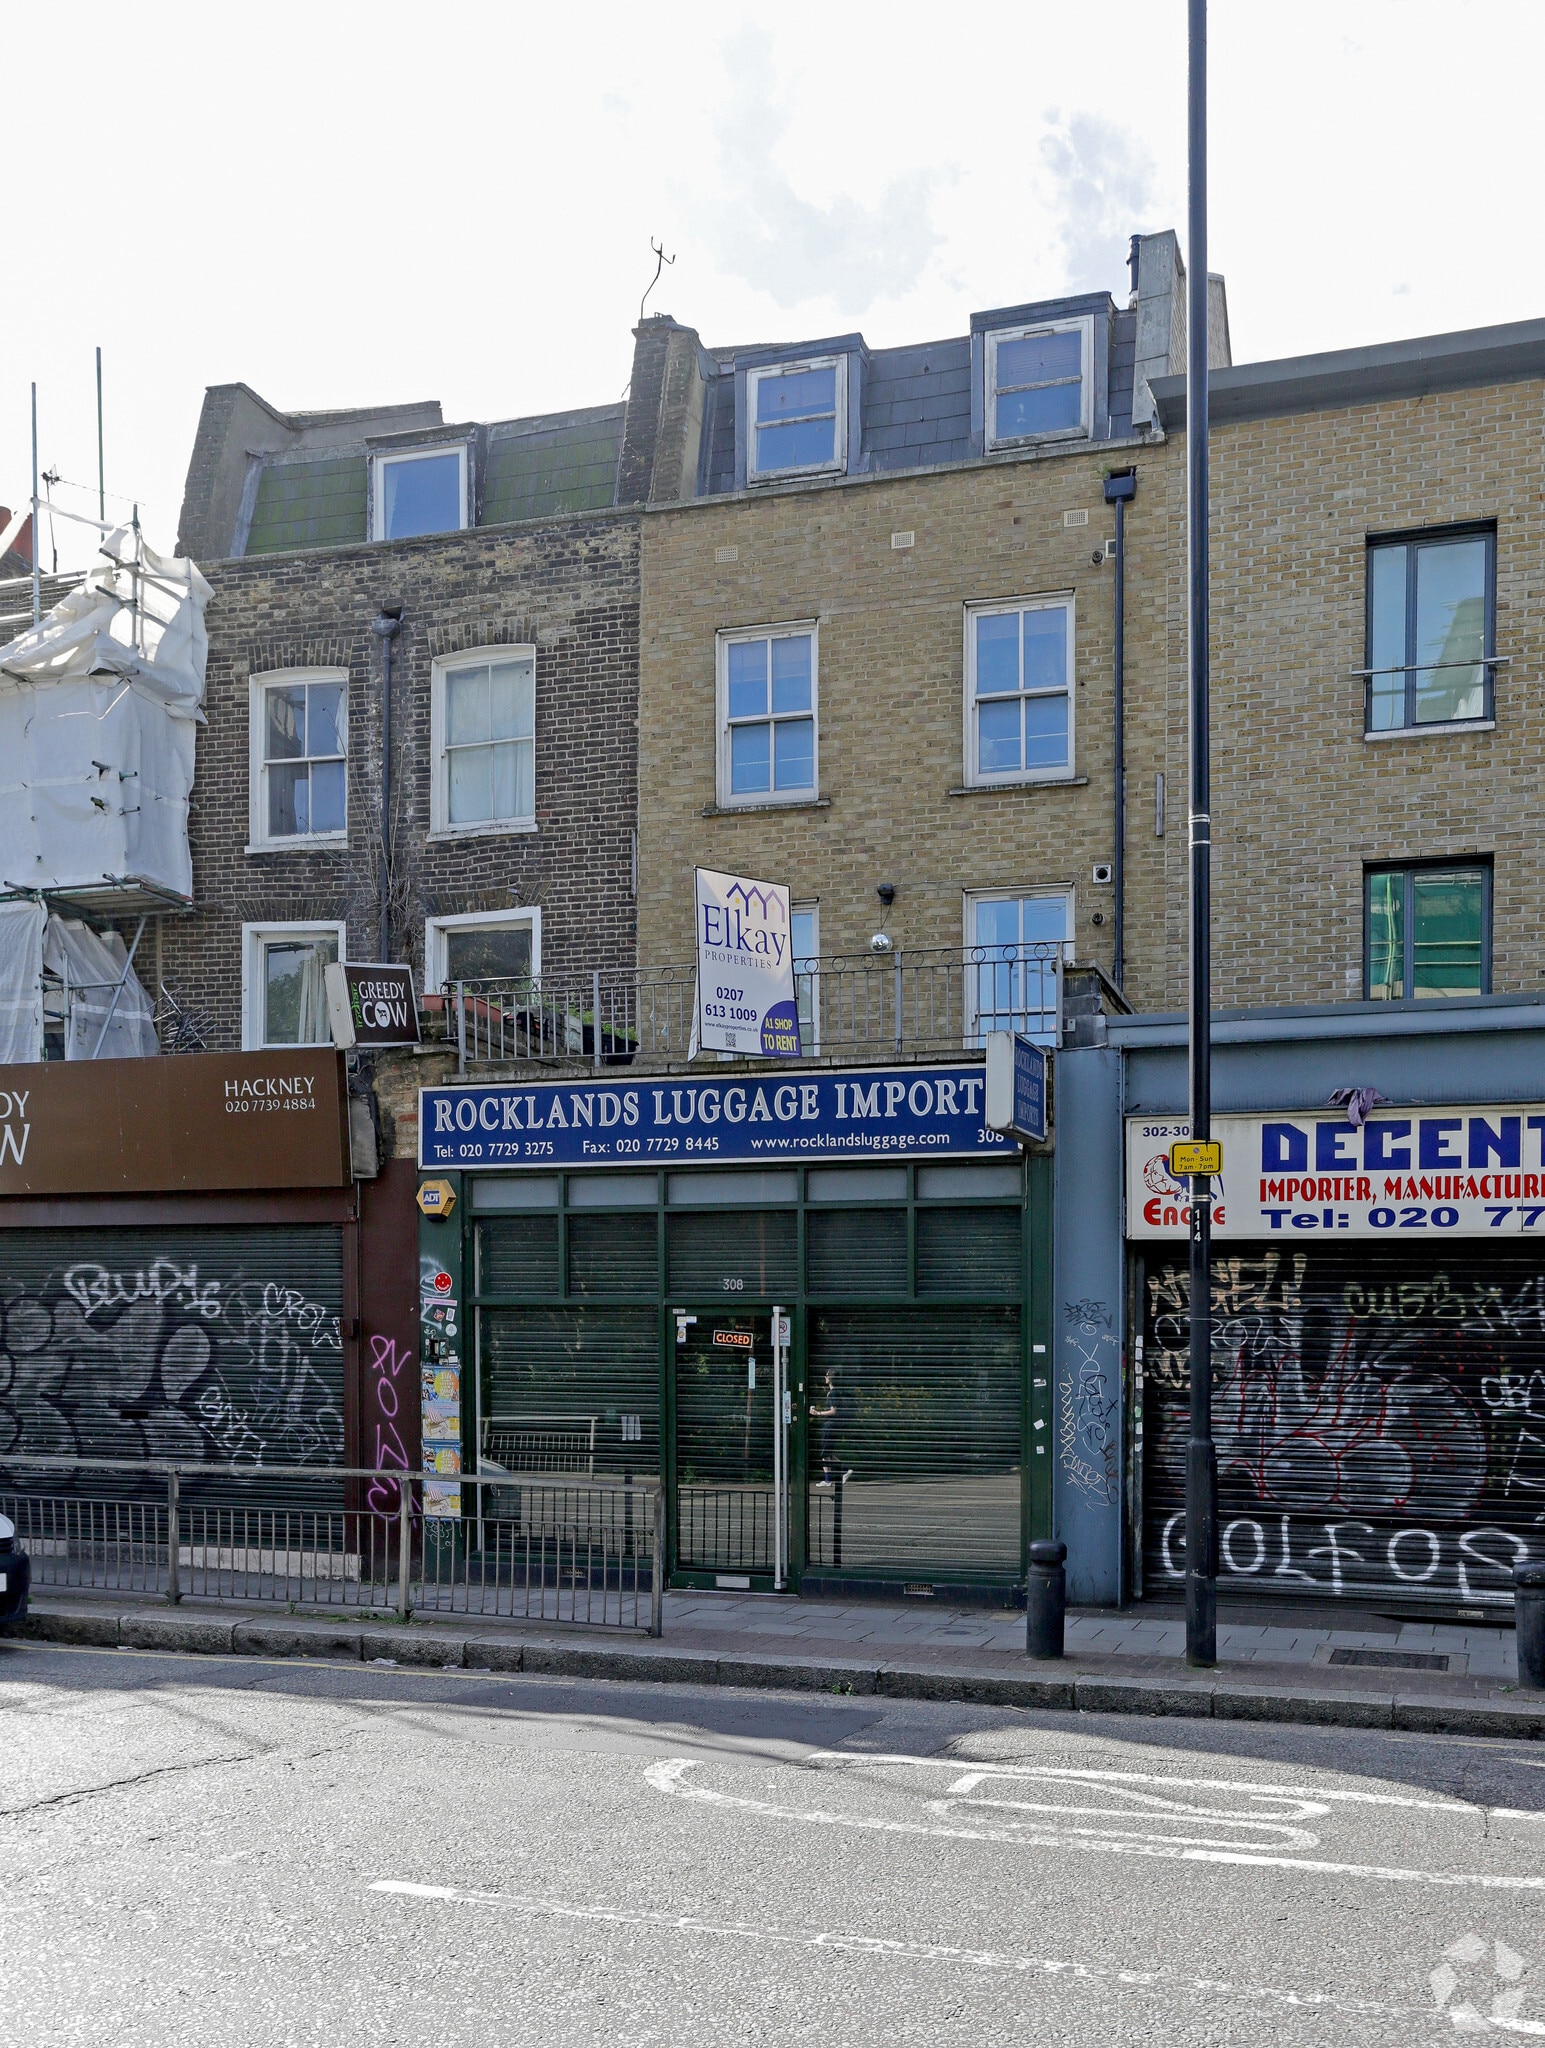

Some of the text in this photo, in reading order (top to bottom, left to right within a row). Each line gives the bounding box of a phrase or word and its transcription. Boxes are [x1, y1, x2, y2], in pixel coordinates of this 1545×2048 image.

[701, 903, 787, 966] Elkay
[704, 950, 772, 969] PROPERTIES
[358, 981, 405, 999] GREEDY
[716, 986, 744, 1001] 0207
[362, 1001, 407, 1028] COW
[705, 1003, 757, 1022] 613 1009
[765, 1017, 793, 1030] A1 SHOP
[763, 1033, 797, 1052] TO RENT
[224, 1077, 316, 1098] HACKNEY
[225, 1098, 316, 1113] 020 7739 4884
[433, 1091, 640, 1132] ROCKLANDS
[652, 1083, 820, 1125] LUGGAGE
[434, 1144, 454, 1158] Tel:
[459, 1143, 483, 1157] 020
[488, 1142, 519, 1156] 7729
[524, 1141, 554, 1155] 3275
[583, 1140, 610, 1154] Fax:
[616, 1139, 640, 1153] 020
[647, 1138, 679, 1152] 7729
[685, 1137, 719, 1151] 8445
[750, 1132, 950, 1150] www.rocklandsluggage.com
[424, 1193, 440, 1203] ADT
[1259, 1174, 1545, 1205] IMPORTER, MANUFACTUR
[1260, 1208, 1350, 1229] Tel:
[1368, 1206, 1460, 1228] 020
[722, 1278, 744, 1291] 308
[716, 1333, 750, 1345] CLOSED
